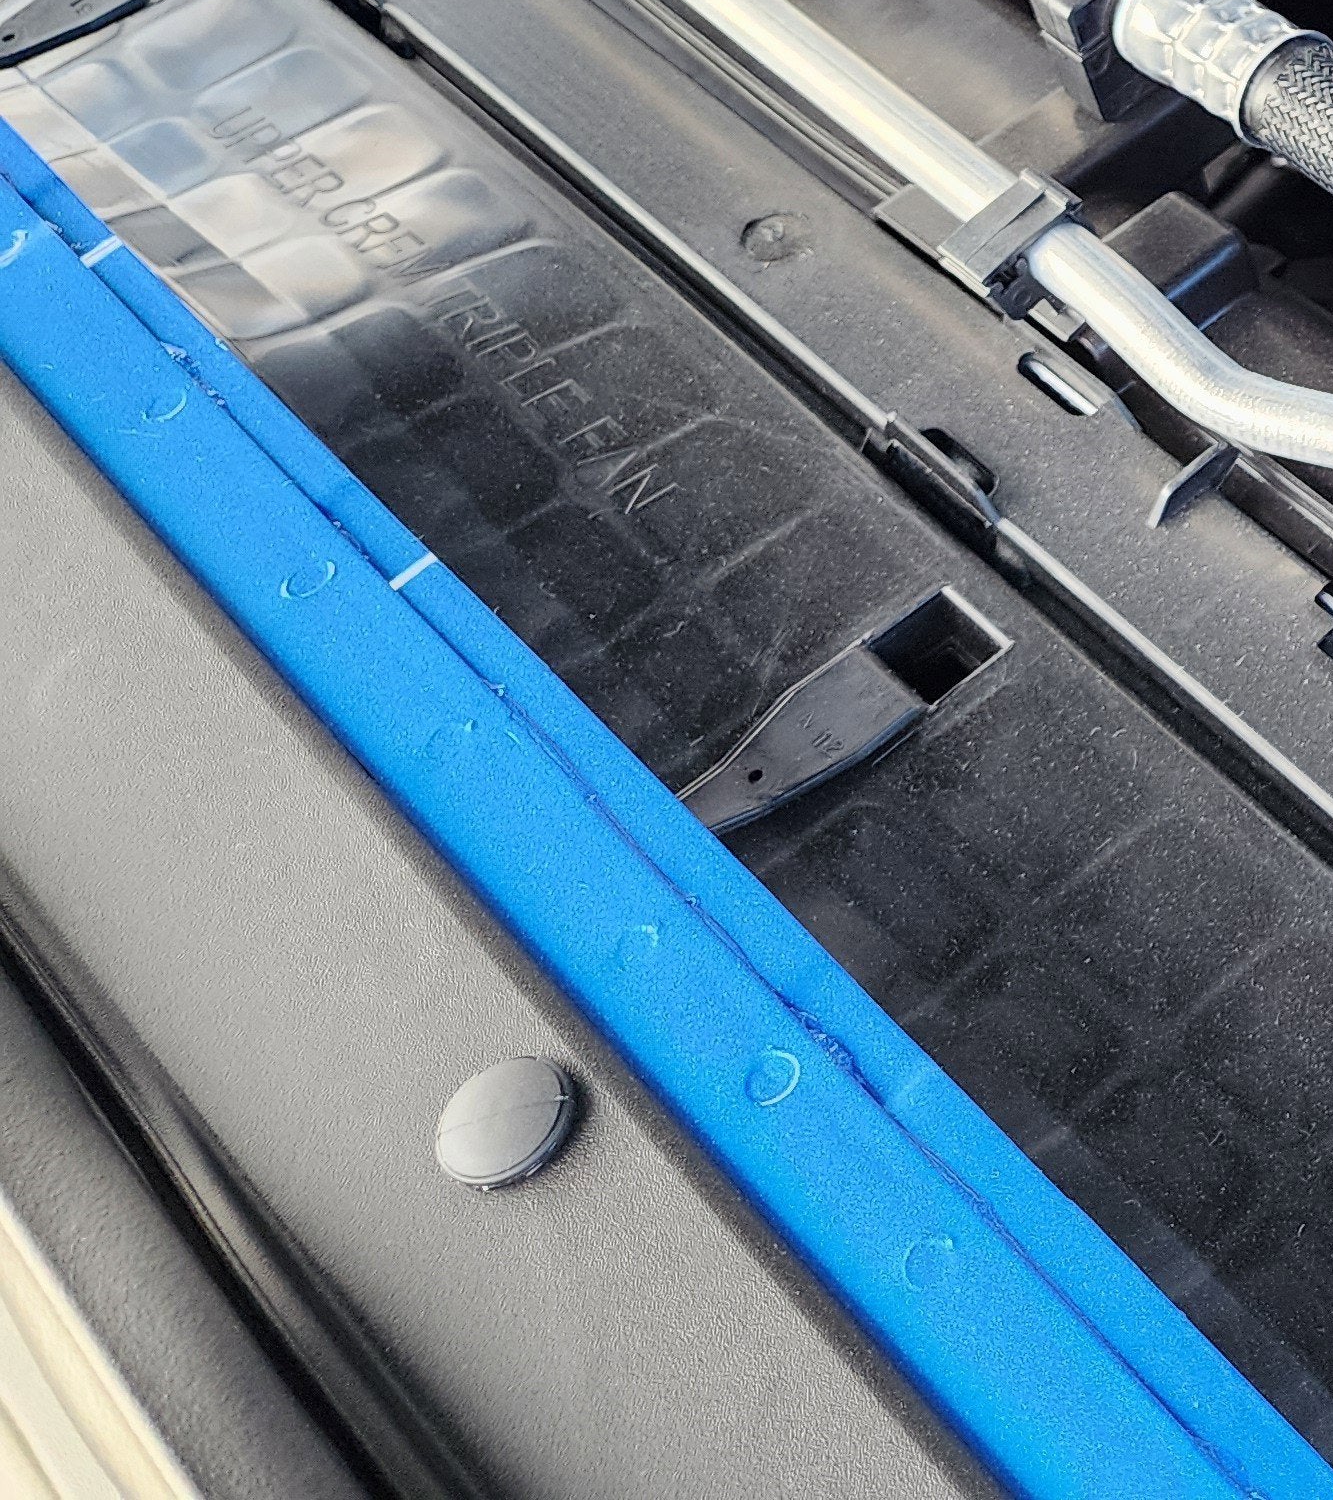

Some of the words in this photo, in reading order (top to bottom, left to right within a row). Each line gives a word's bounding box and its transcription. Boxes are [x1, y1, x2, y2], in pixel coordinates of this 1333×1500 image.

[210, 105, 345, 209] UPPER
[427, 278, 593, 420] TRIPLE
[558, 414, 687, 515] FAN
